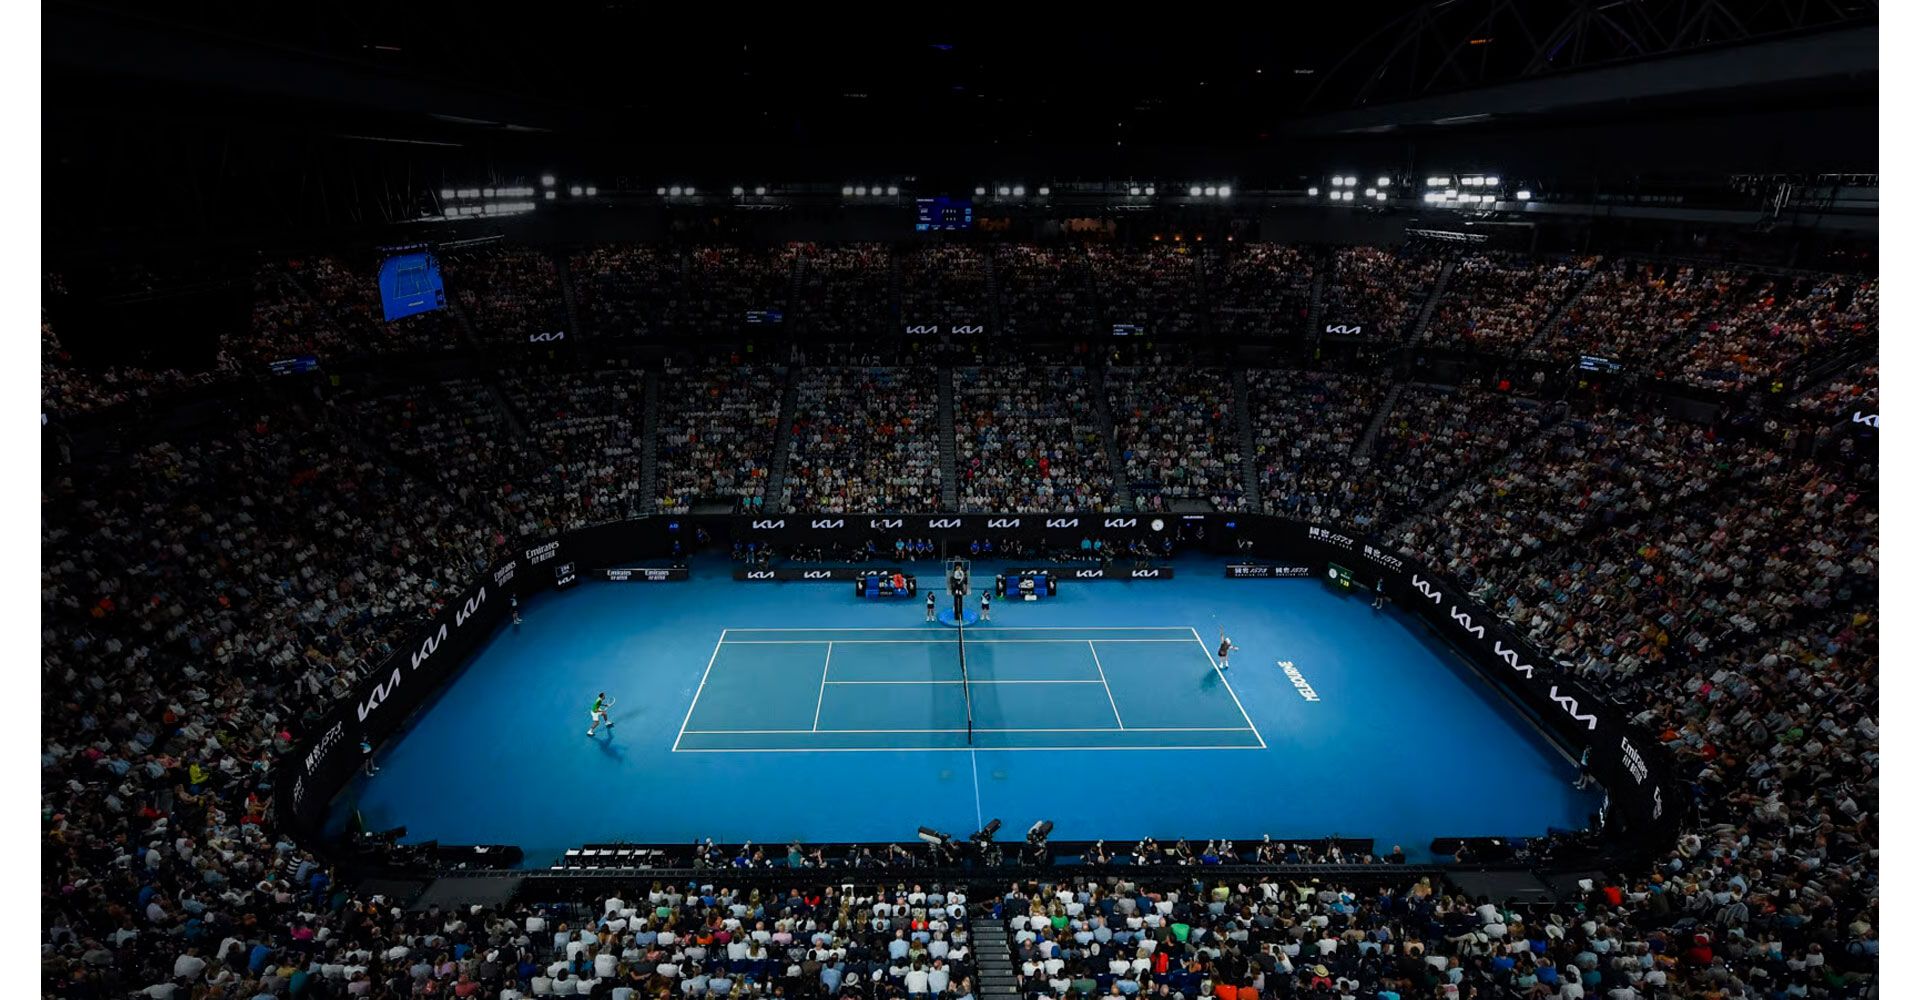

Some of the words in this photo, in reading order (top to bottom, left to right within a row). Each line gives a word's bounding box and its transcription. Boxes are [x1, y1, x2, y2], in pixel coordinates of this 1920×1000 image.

[752, 519, 784, 529] KIA
[811, 519, 843, 529] KIA
[929, 518, 961, 528] KIA
[987, 518, 1019, 528] KIA
[1046, 518, 1078, 528] KIA
[1104, 518, 1136, 528] KIA
